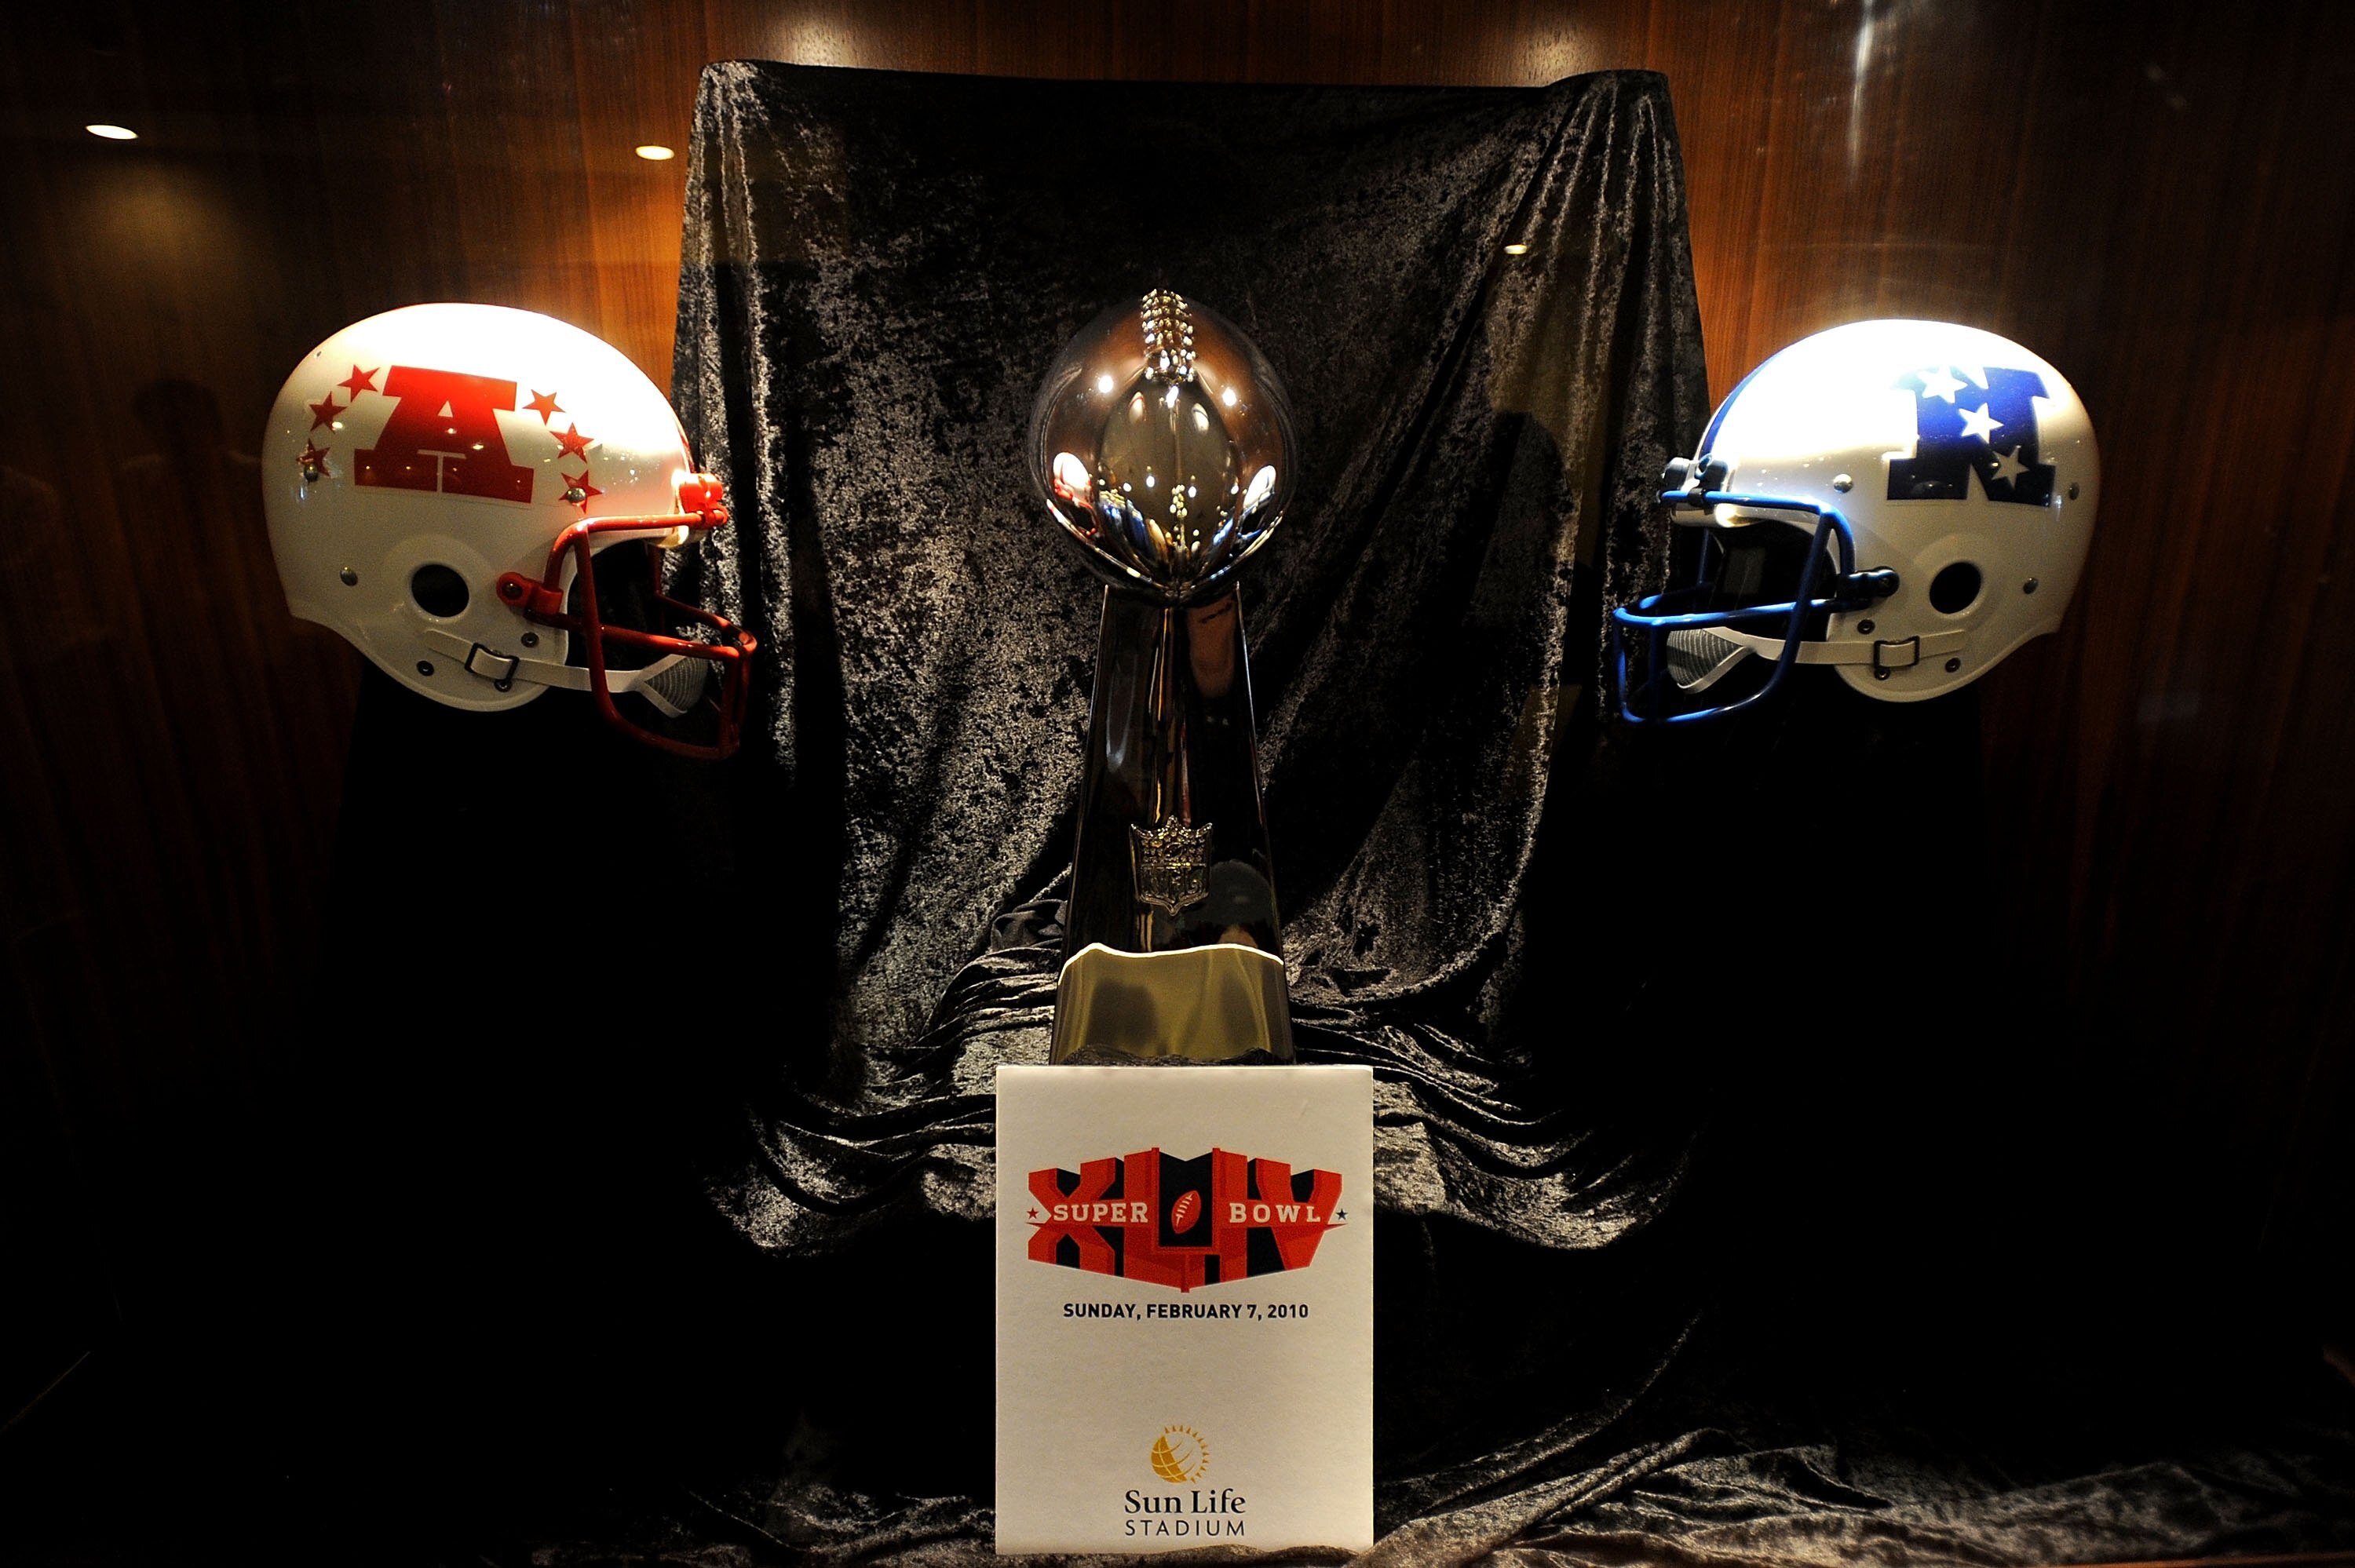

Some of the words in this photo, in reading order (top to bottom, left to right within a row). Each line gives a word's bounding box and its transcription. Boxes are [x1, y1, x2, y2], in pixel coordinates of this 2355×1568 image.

[354, 365, 535, 504] A
[1886, 366, 2056, 508] N
[1028, 1147, 1343, 1293] XLIV
[1053, 1202, 1148, 1223] SUPER
[1229, 1202, 1321, 1223] BOWL
[1063, 1303, 1141, 1322] SUNDAY,
[1146, 1304, 1243, 1319] FEBRUARY
[1247, 1304, 1262, 1322] 7,
[1267, 1304, 1309, 1319] 2010
[1124, 1490, 1182, 1515] Sun
[1191, 1488, 1246, 1515] Life
[1125, 1519, 1246, 1537] STADIUM
